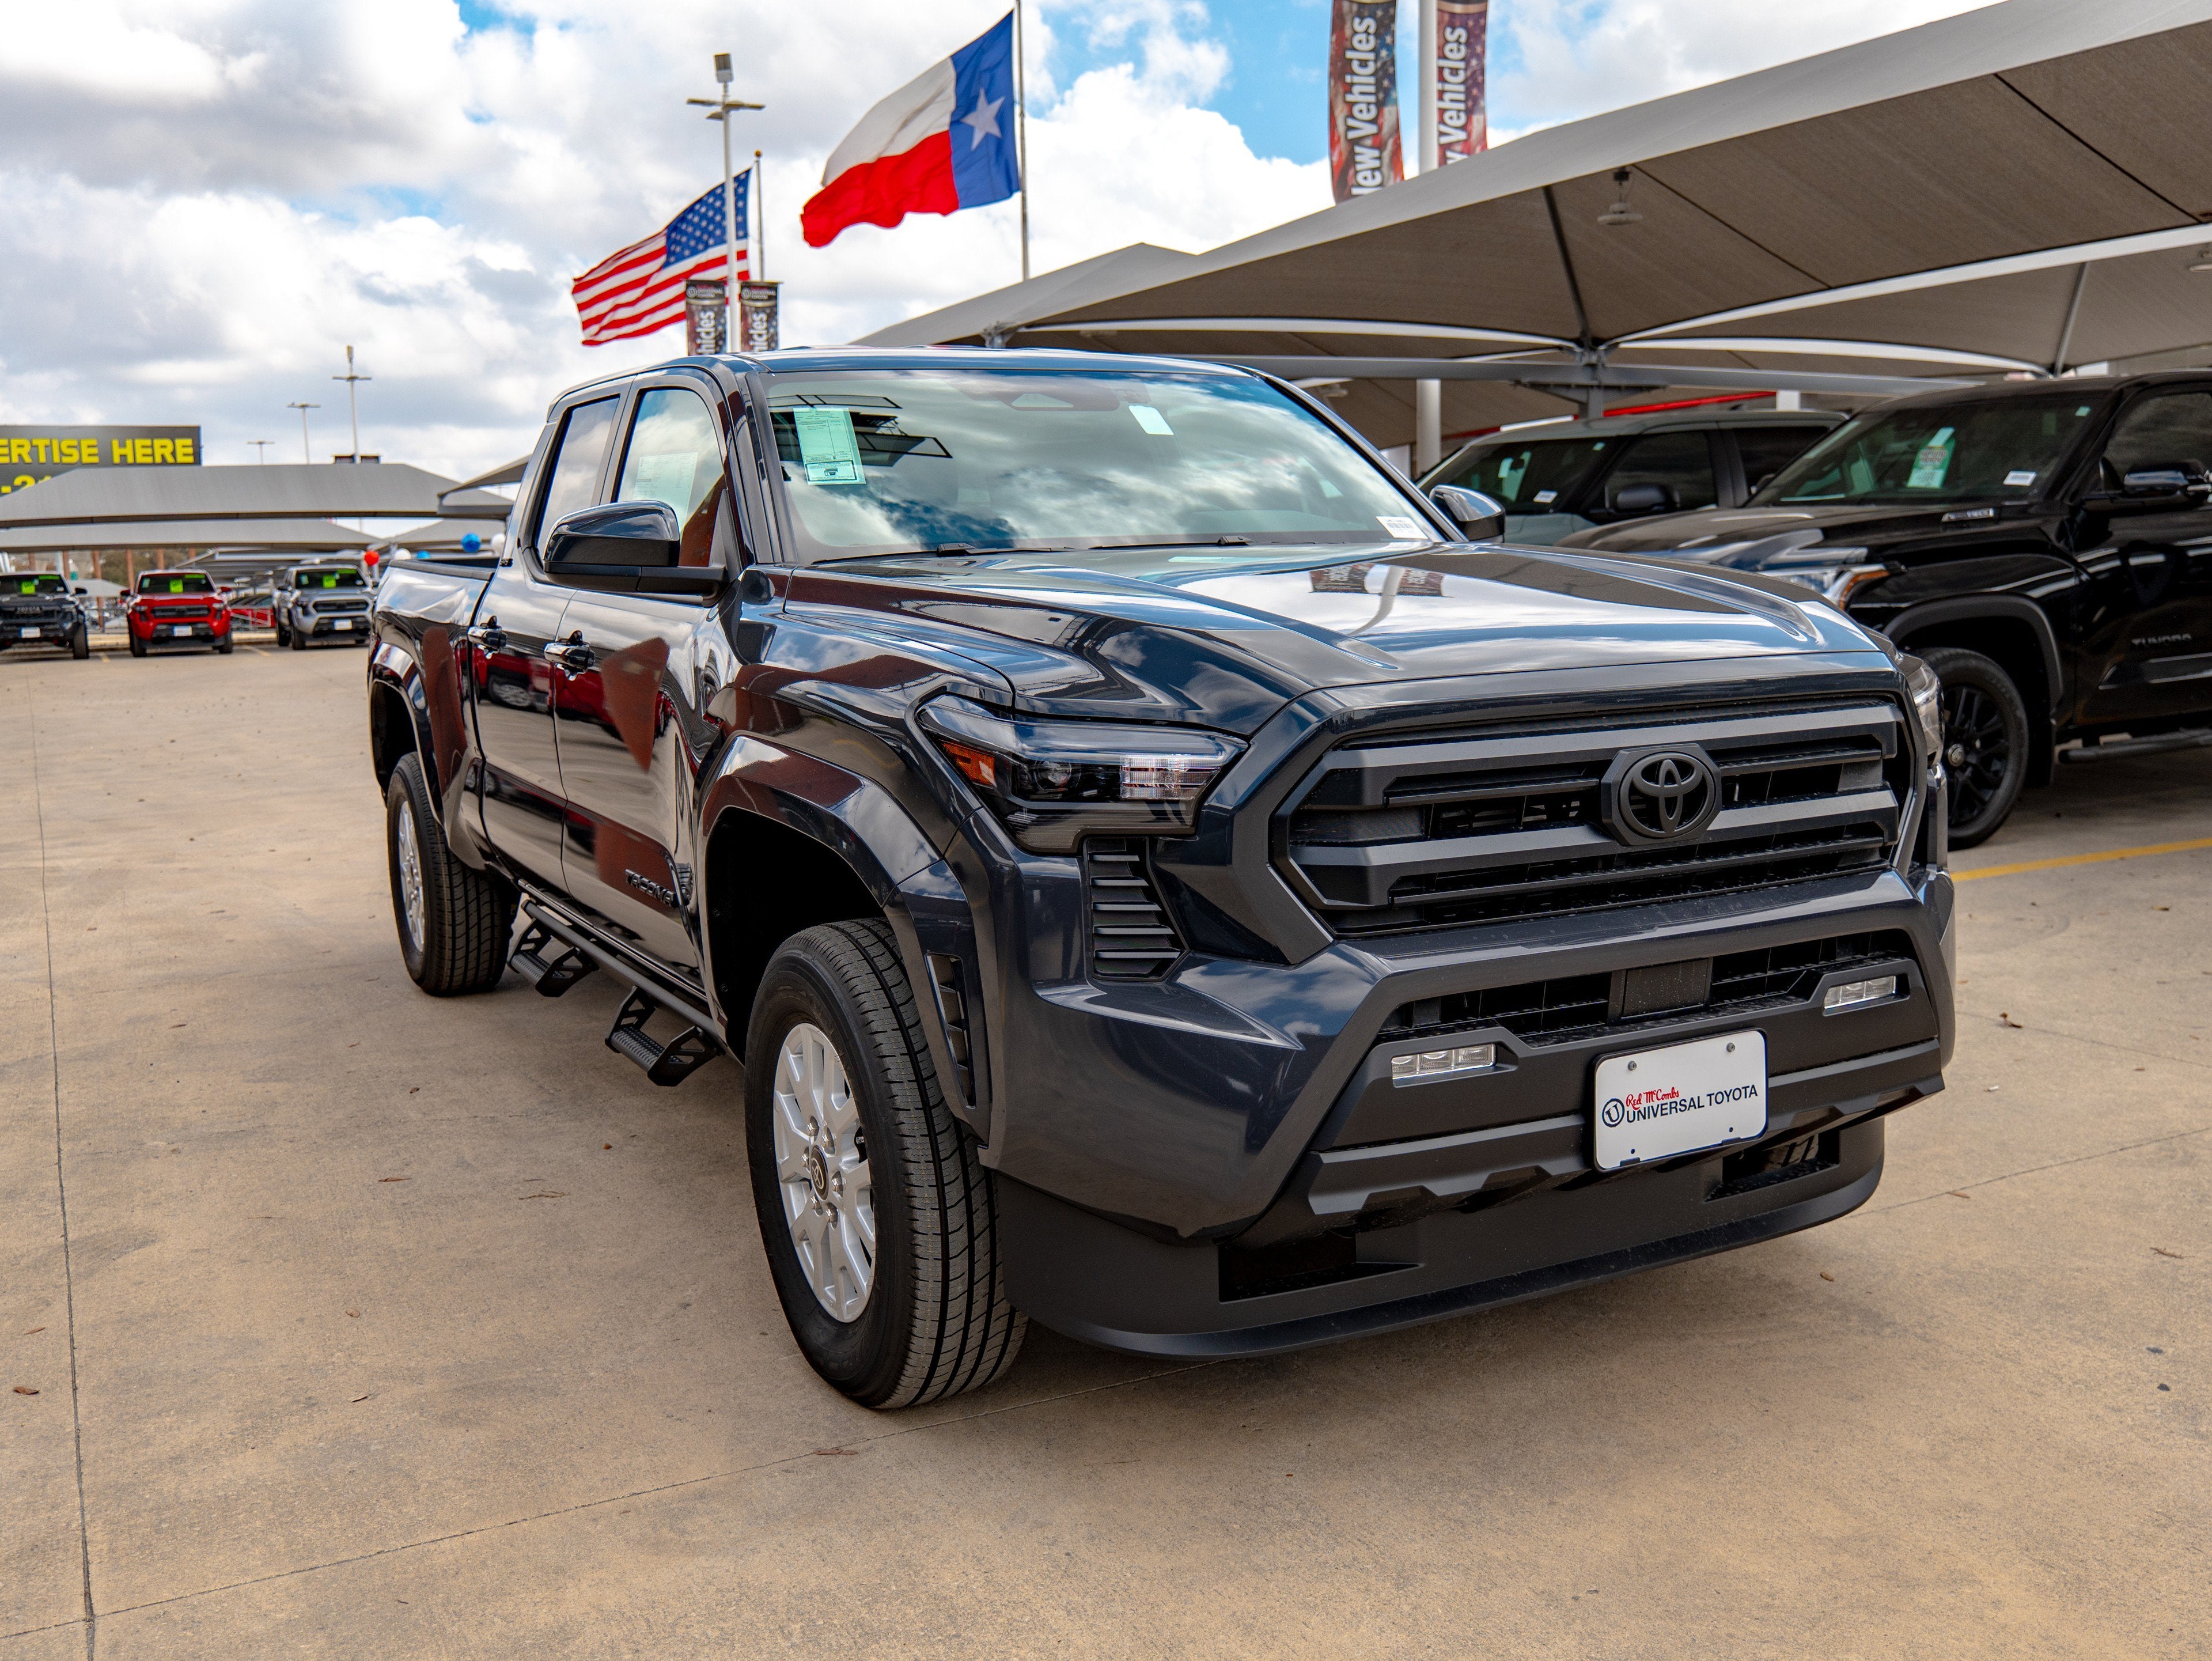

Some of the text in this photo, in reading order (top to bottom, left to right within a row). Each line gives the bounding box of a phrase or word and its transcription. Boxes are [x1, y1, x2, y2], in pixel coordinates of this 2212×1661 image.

[1345, 16, 1379, 139] Vehicles
[1438, 26, 1468, 145] Vehicles
[111, 438, 194, 464] HERE
[1626, 1094, 1642, 1110] Red
[1626, 1084, 1758, 1123] UNIVERSAL TOYOTA
